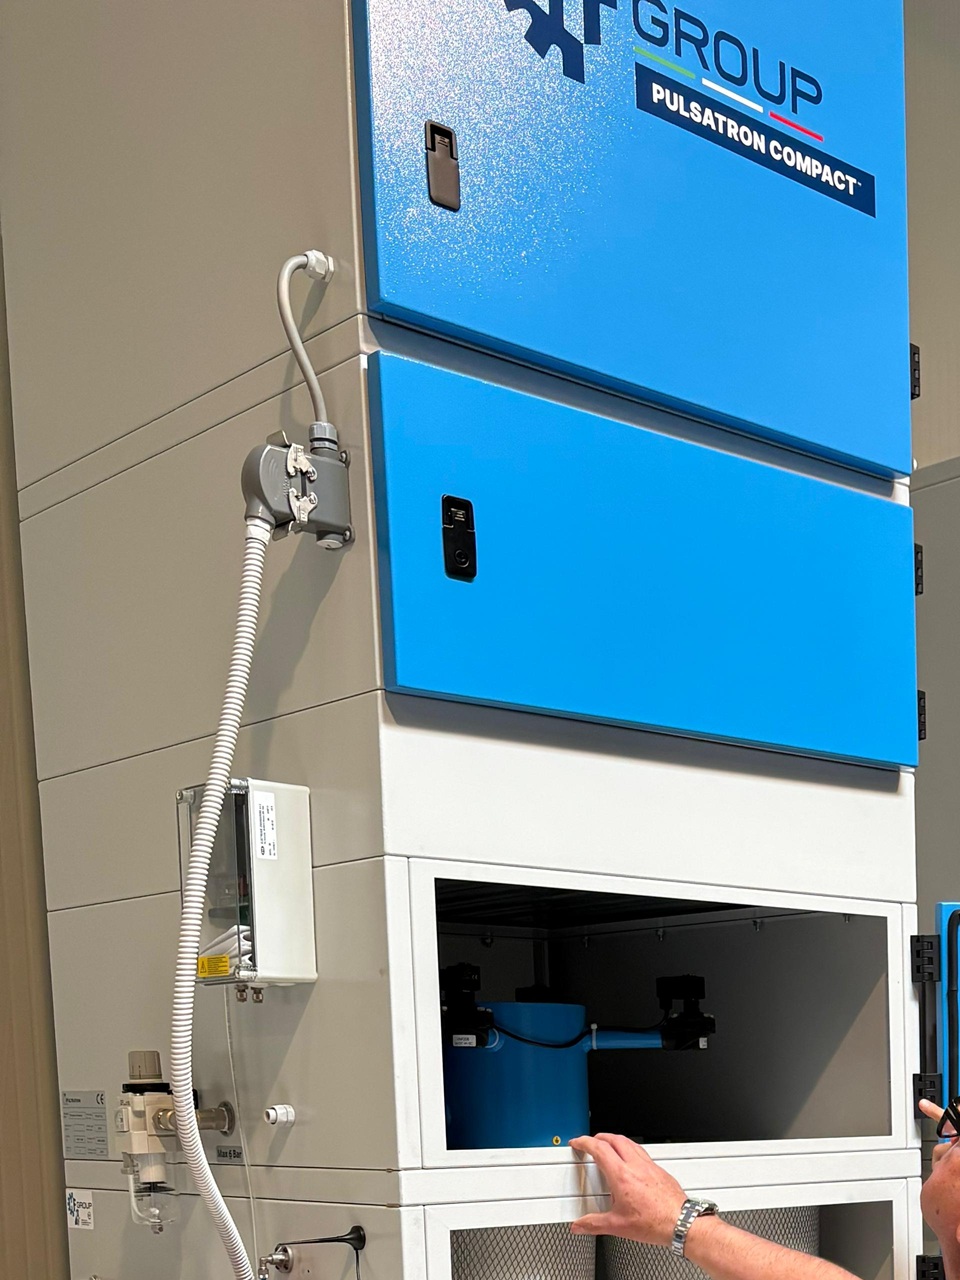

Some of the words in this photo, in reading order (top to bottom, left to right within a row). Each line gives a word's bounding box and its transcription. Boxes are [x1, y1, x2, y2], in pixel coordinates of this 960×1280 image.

[632, 0, 823, 115] GROUP
[651, 82, 766, 154] PULSATRON
[217, 1149, 228, 1158] Max
[233, 1149, 242, 1158] Bar
[76, 1201, 93, 1210] GROUP
